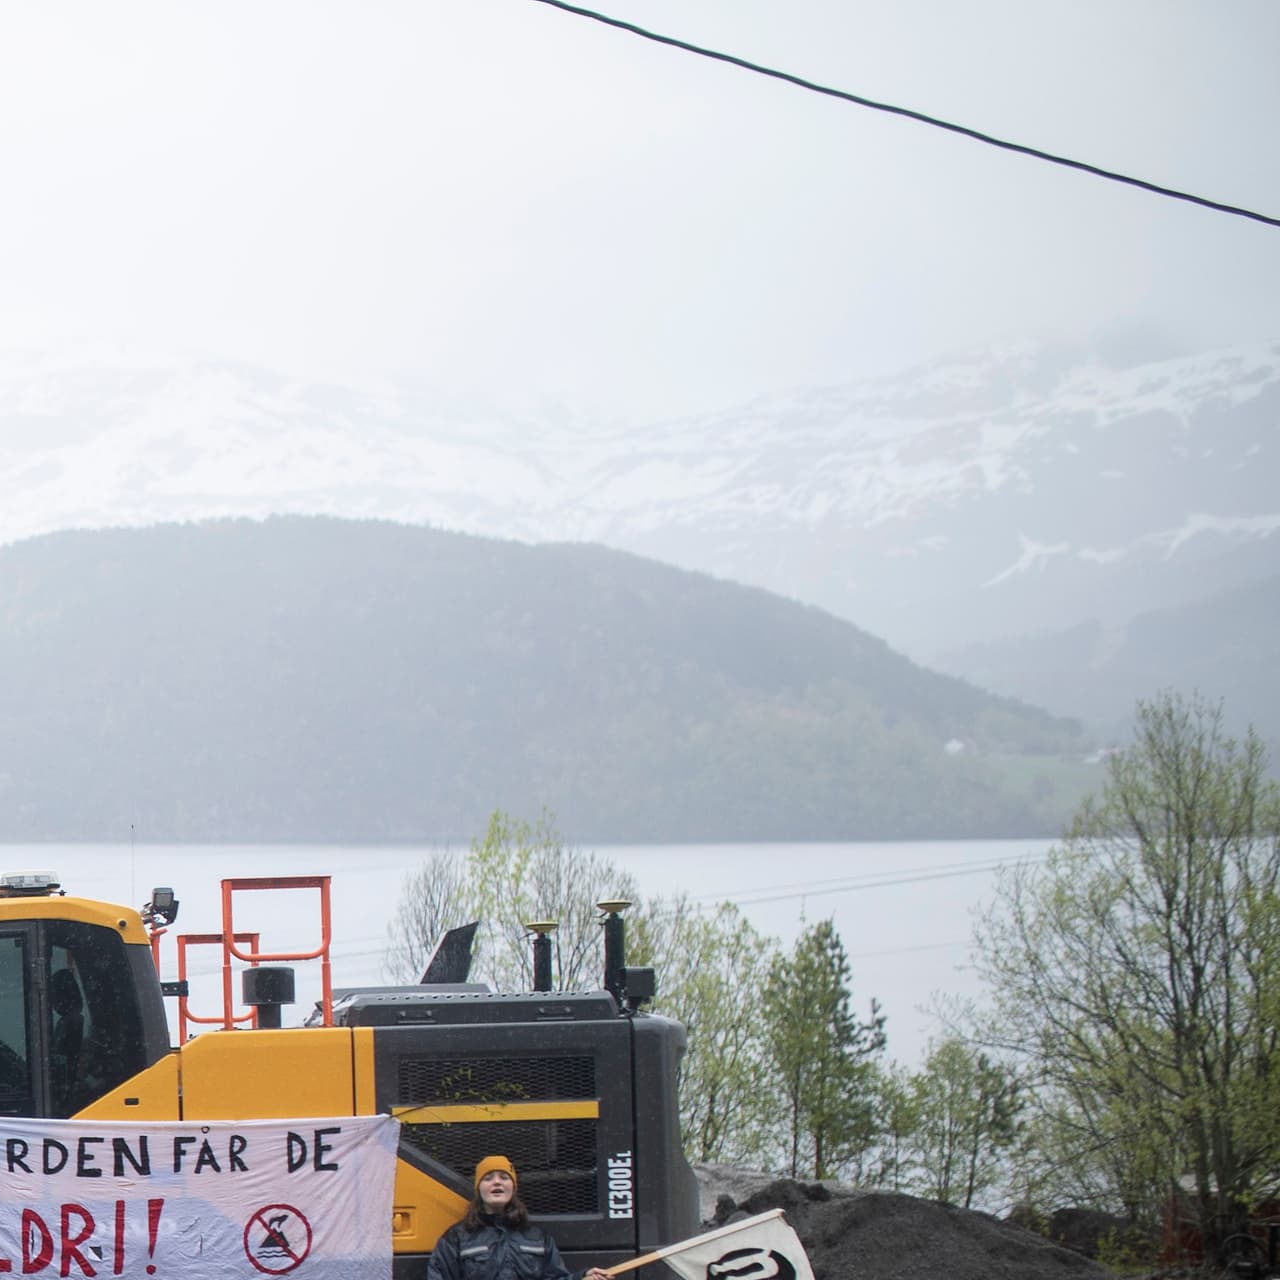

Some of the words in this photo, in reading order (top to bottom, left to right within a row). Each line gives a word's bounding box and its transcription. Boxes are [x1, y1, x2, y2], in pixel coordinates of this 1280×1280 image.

[173, 1126, 249, 1174] FÅR
[287, 1126, 341, 1173] DE
[608, 1150, 633, 1219] EC300EL
